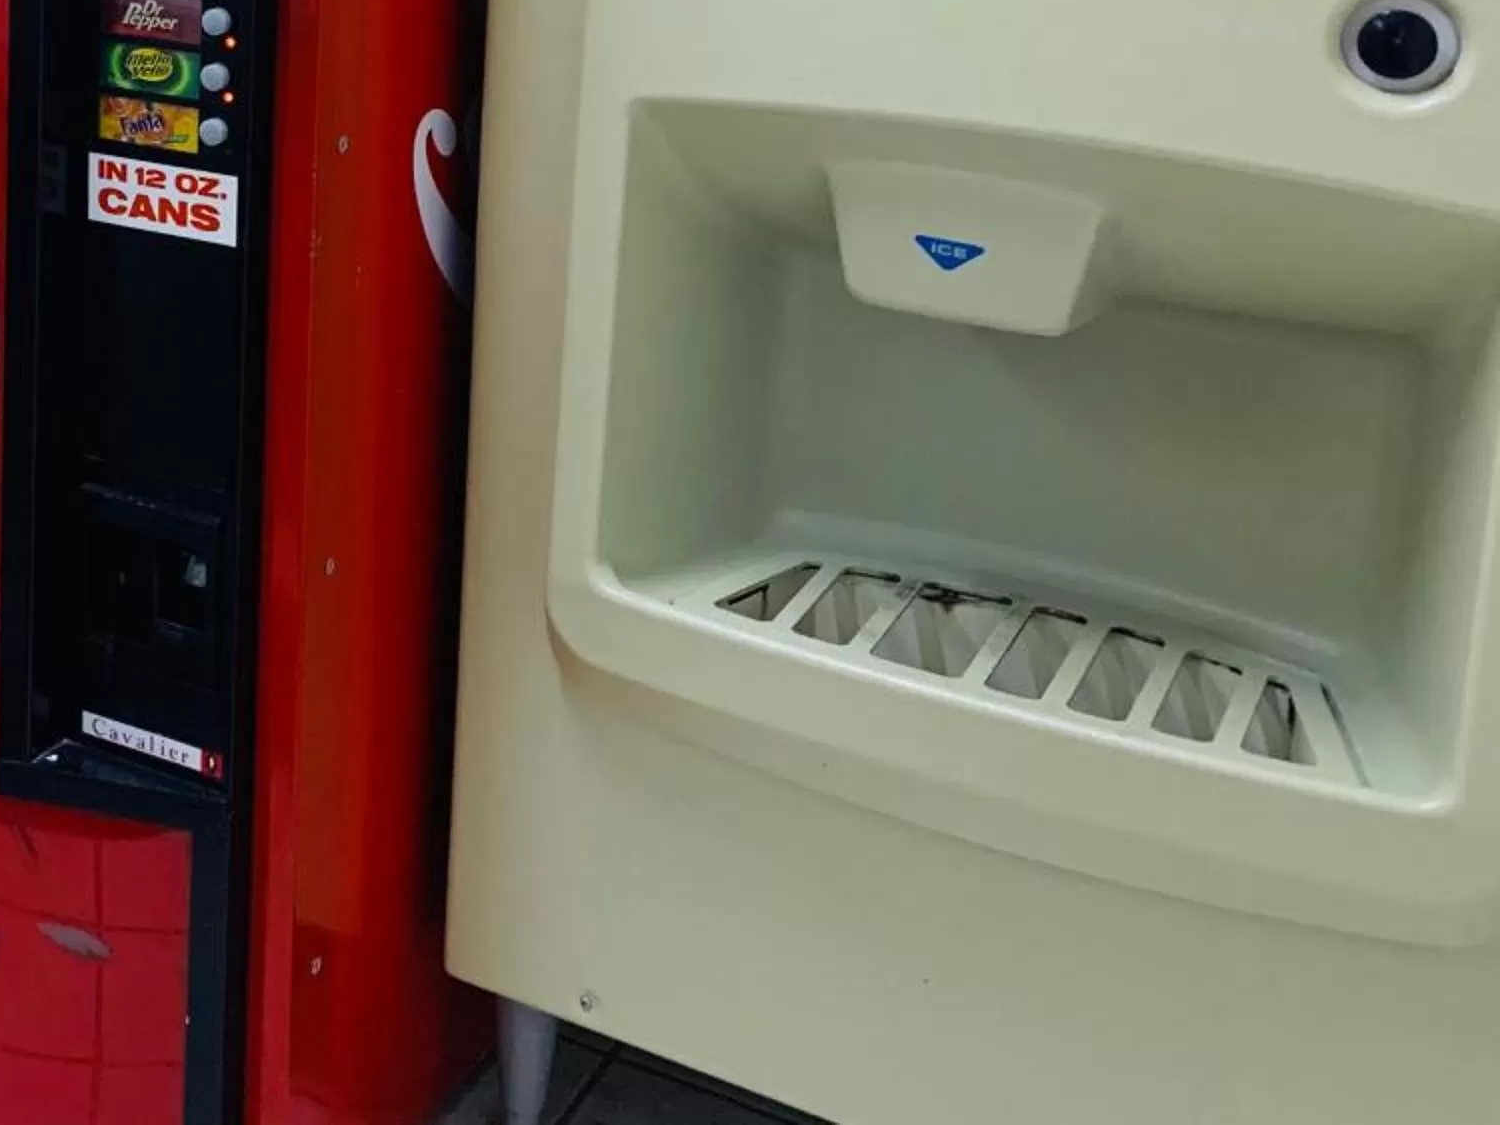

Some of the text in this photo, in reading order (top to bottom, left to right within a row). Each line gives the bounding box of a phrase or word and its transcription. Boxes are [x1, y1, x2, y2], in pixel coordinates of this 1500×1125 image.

[123, 2, 179, 31] Pepper
[142, 0, 165, 16] Dr
[120, 114, 165, 135] Fanta
[97, 159, 227, 200] IN 12 OZ.
[97, 188, 222, 233] CANS
[91, 717, 190, 764] Cavalier
